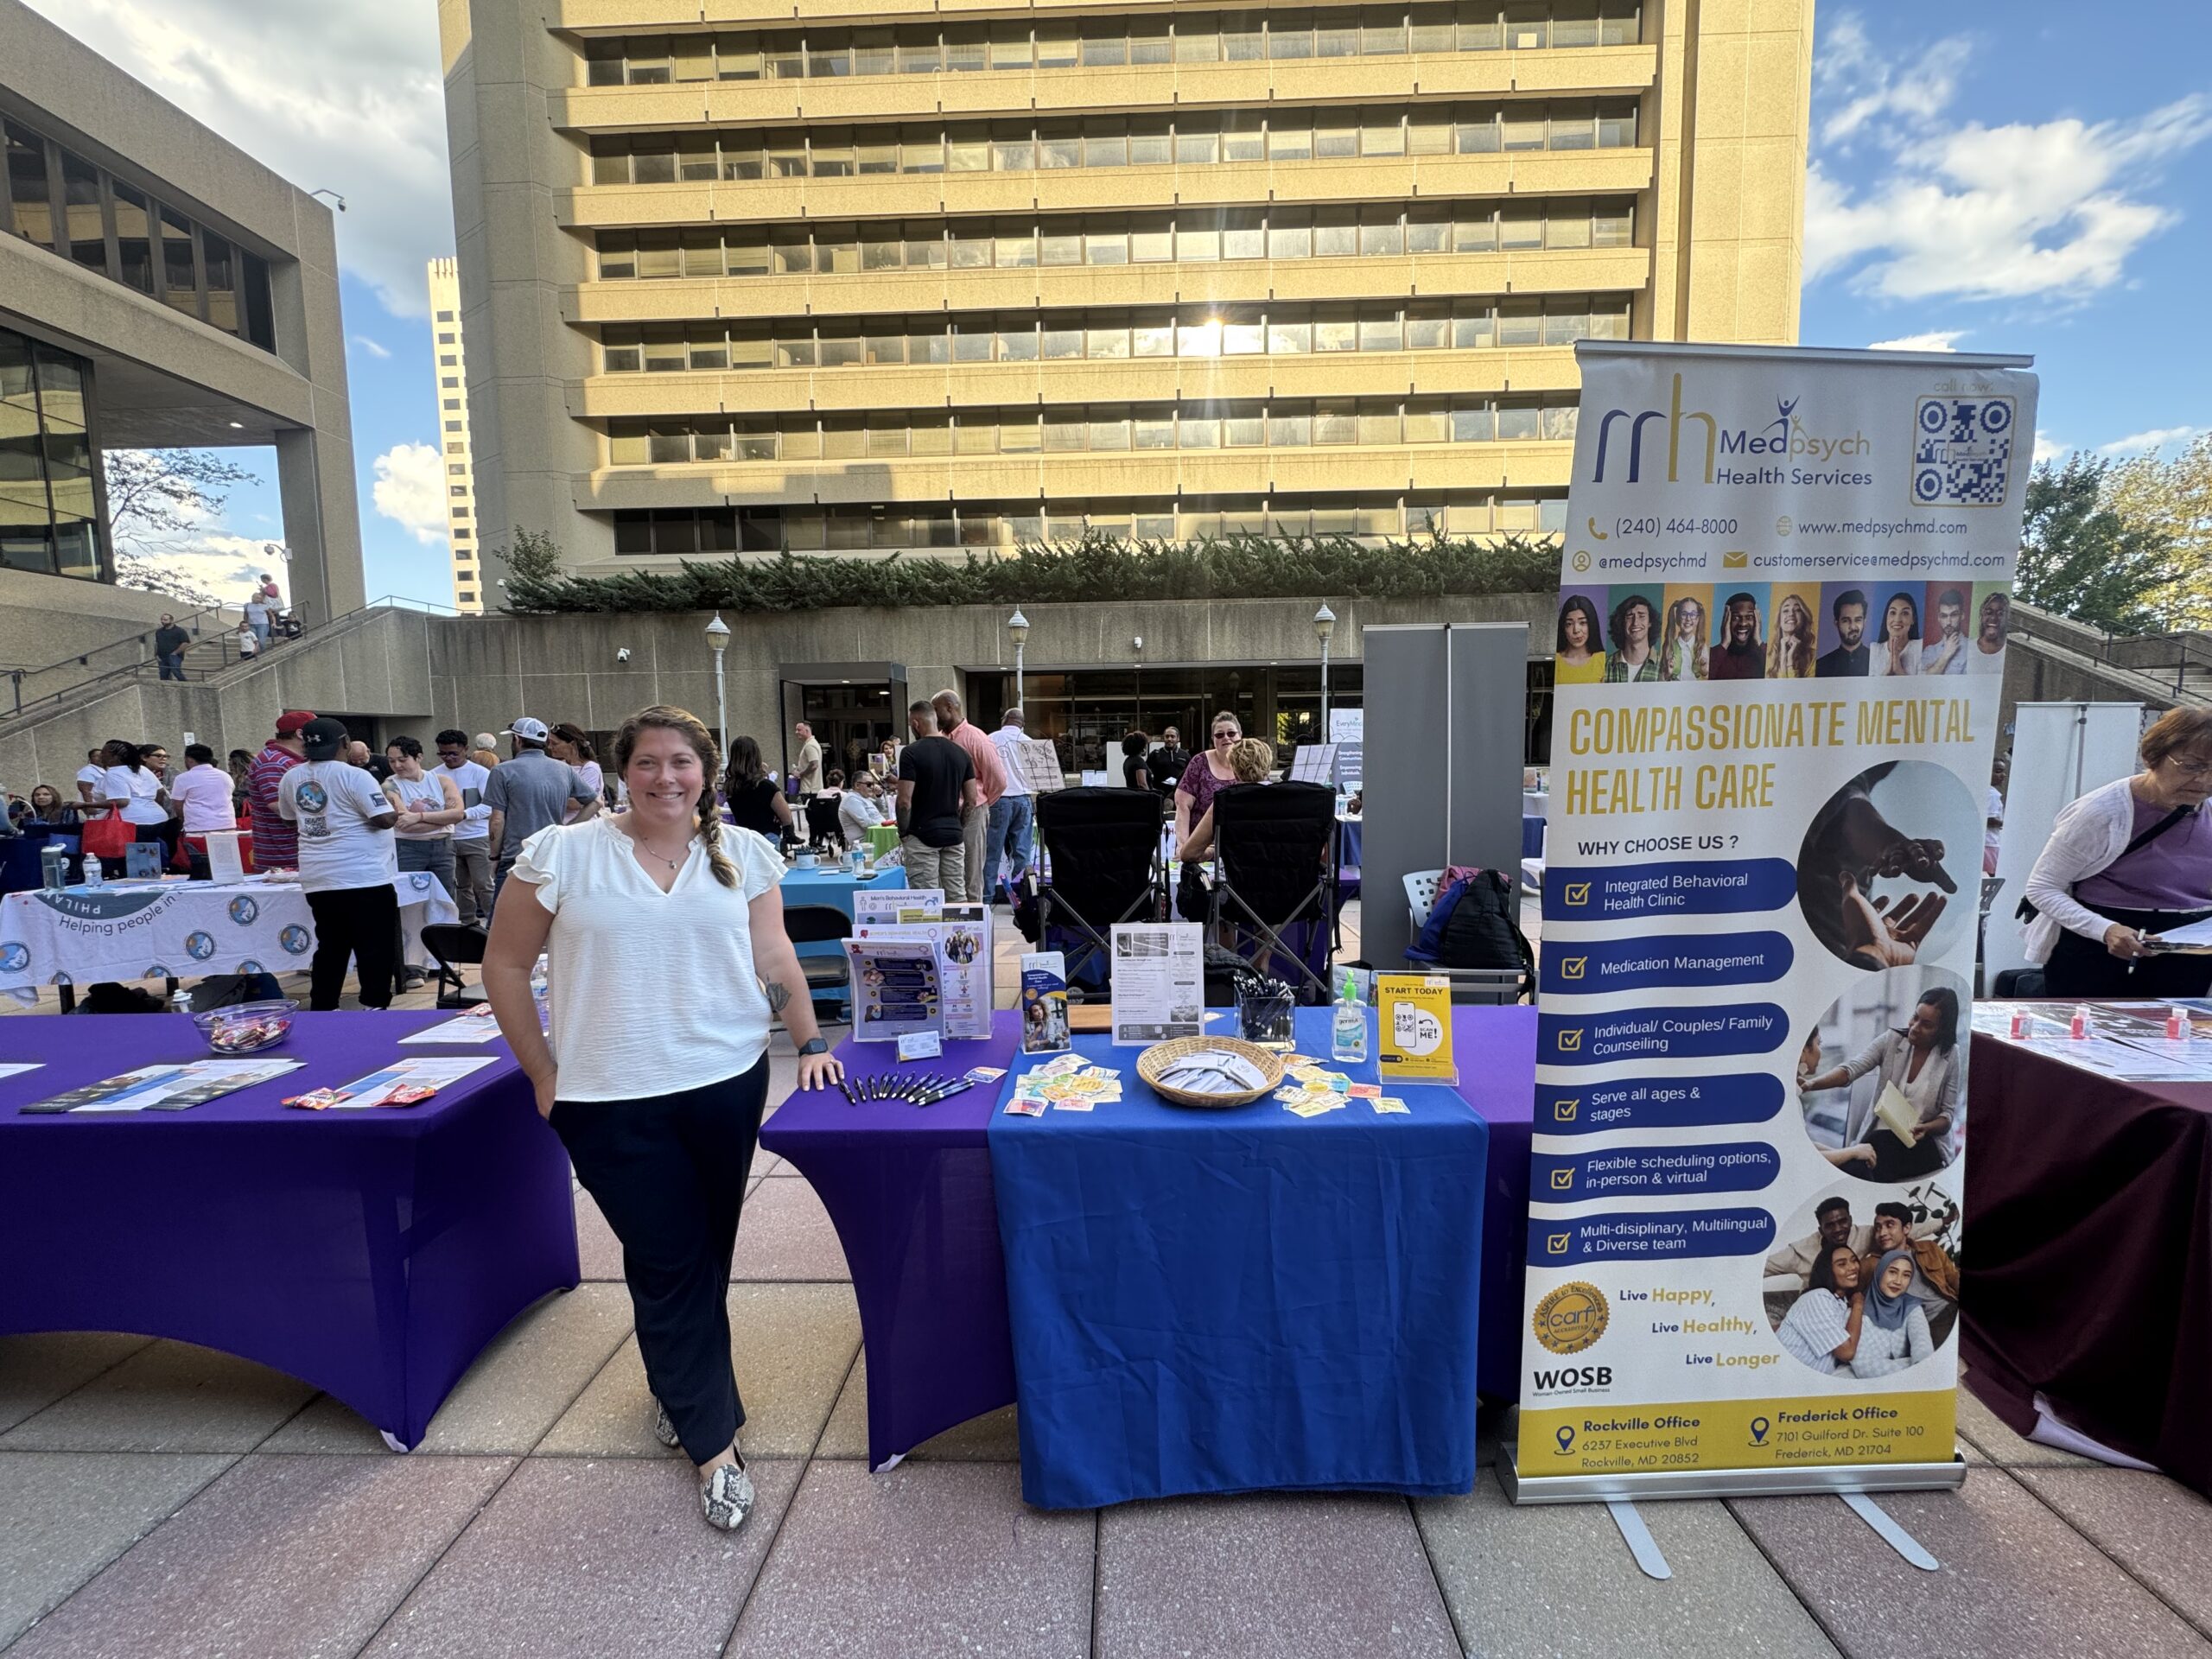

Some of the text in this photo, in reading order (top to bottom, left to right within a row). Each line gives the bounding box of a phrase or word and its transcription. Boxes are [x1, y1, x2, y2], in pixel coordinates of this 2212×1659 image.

[1720, 411, 1871, 463] Medpsych
[1717, 467, 1873, 486] Health Services
[1616, 517, 1738, 538] (240) 464-8000
[1798, 517, 1967, 537] www.medpsychmd.com
[1599, 551, 1707, 573] @medpsychmd
[1752, 550, 2005, 570] customerservice@medpsychmd.com
[1569, 699, 1975, 755] COMPASSIONATE MENTAL
[1566, 763, 1777, 815] HEALTH CARE
[1577, 835, 1739, 855] WHY CHOOSE US ?
[1605, 873, 1749, 895] Integrated Behavioral
[1604, 893, 1686, 911] Health Clinic
[59, 894, 176, 937] Helping people in
[1600, 953, 1764, 975] Medication Management
[1420, 1028, 1438, 1039] ME!
[1594, 1015, 1773, 1039] Individual/ Couples/ Family
[1591, 1086, 1700, 1106] Serve all ages &
[1590, 1106, 1631, 1122] stages
[1587, 1151, 1772, 1173] Flexible scheduling options,
[1586, 1169, 1707, 1189] in-person & virtual
[1580, 1217, 1768, 1238] Multi-disiplinary, Multilingual
[1583, 1236, 1687, 1253] & Diverse team
[1540, 1292, 1563, 1318] ASPIRE
[1619, 1287, 1715, 1306] Live Happy,
[1550, 1305, 1596, 1326] carf
[1652, 1316, 1758, 1336] Live Healthy,
[1686, 1352, 1781, 1370] Live Longer
[1533, 1366, 1613, 1389] WOSB
[1583, 1415, 1700, 1433] Rockville Office
[1778, 1406, 1898, 1423] Frederick Office
[1581, 1435, 1698, 1452] 6237 Executive Blvd
[1776, 1426, 1924, 1442] 7101 Guilford Dr. Suite 100
[1581, 1452, 1700, 1469] Rockville, MD 20852
[1775, 1445, 1892, 1460] Frederick, MD 21704
